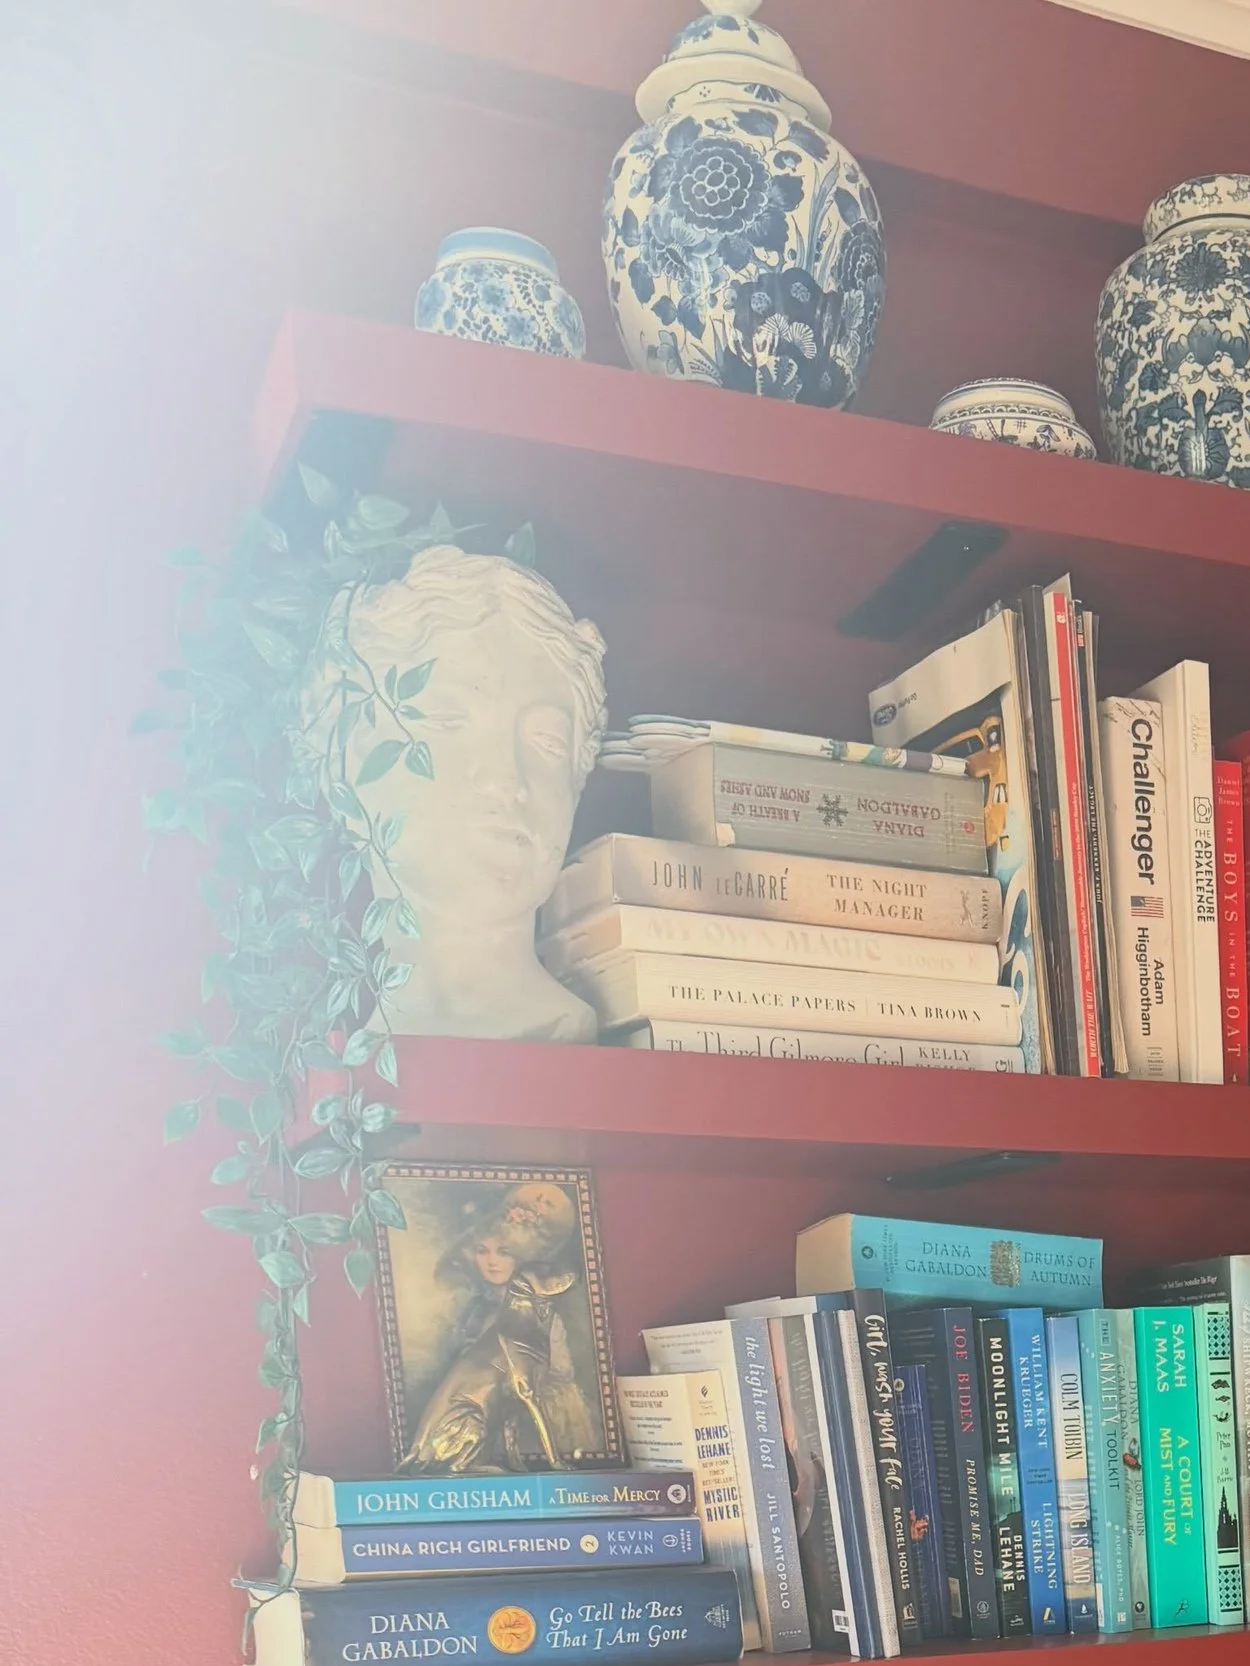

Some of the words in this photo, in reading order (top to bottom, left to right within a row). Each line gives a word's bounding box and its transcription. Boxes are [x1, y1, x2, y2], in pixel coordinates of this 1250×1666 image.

[857, 797, 942, 820] GABALDON
[1129, 718, 1155, 885] Challenger
[872, 820, 925, 838] DIANA
[826, 873, 863, 891] THE
[872, 877, 927, 898] NIGHT
[1193, 838, 1206, 923] CHALLENGE
[1203, 841, 1216, 923] ADVENTURE
[833, 898, 925, 922] MANAGER
[981, 888, 990, 930] KNOPF
[1133, 926, 1152, 1037] Higginbotham
[1151, 958, 1165, 1005] Adam
[668, 984, 706, 1001] THE
[712, 988, 784, 1008] PALACE
[791, 995, 857, 1012] PAPERS
[876, 1002, 918, 1018] TINA
[924, 1006, 984, 1023] BROWN
[921, 1241, 972, 1258] DIANA
[904, 1259, 989, 1278] GABALDON
[1029, 1270, 1093, 1287] AUTUMN
[952, 1323, 969, 1361] JOE
[1171, 1323, 1188, 1389] SARAH
[956, 1373, 975, 1433] BIDEN
[988, 1336, 1010, 1445] MOONLIGHT
[1019, 1356, 1033, 1430] KRUEGER
[695, 1423, 729, 1441] DENNIS
[697, 1442, 732, 1459] LEHANE
[998, 1452, 1014, 1497] MILE
[356, 1492, 420, 1515] JOHN
[428, 1488, 532, 1511] GRISHAM
[703, 1486, 738, 1505] MYSTIC
[767, 1491, 777, 1520] JILL
[706, 1505, 741, 1523] RIVER
[353, 1537, 414, 1558] CHINA
[419, 1538, 464, 1556] RICH
[468, 1535, 571, 1554] GIRLFRIEND
[607, 1529, 655, 1543] KEVIN
[609, 1542, 655, 1557] KWAN
[1030, 1519, 1044, 1574] STRIKE
[1042, 1502, 1059, 1590] LIGHTNING
[771, 1525, 791, 1610] SANTOPOLO
[998, 1526, 1015, 1592] LEHANE
[1013, 1535, 1026, 1581] DENNIS
[370, 1611, 451, 1635] DIANA
[548, 1605, 575, 1631] Go
[579, 1603, 616, 1624] Tell
[621, 1602, 644, 1620] the
[645, 1602, 684, 1619] Bees
[342, 1635, 478, 1663] GABALDON
[546, 1629, 587, 1650] That
[614, 1627, 641, 1646] Am
[648, 1625, 689, 1646] Gone
